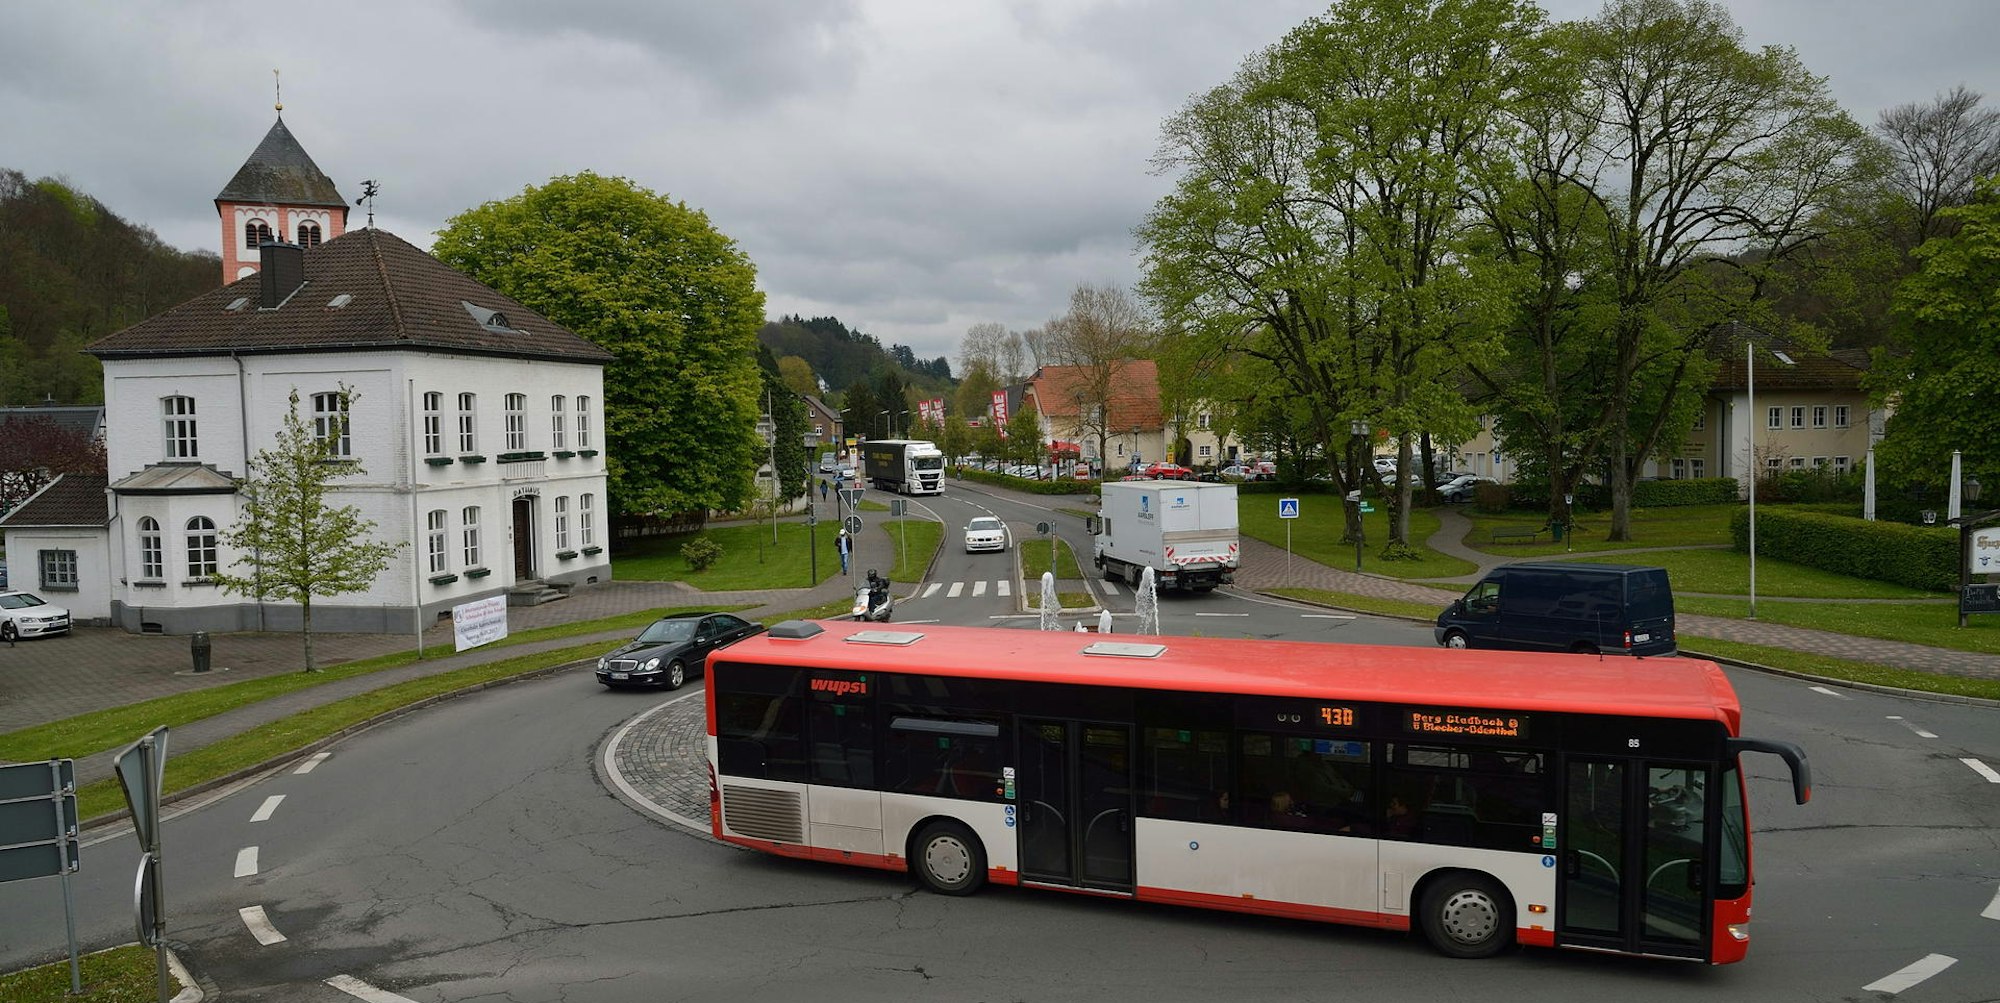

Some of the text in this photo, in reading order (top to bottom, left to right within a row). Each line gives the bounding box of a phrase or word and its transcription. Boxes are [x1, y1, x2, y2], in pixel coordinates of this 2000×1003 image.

[513, 486, 541, 497] RATHAUS
[811, 676, 867, 696] wupsi
[1321, 707, 1353, 726] 430
[1412, 713, 1442, 724] Berg
[1446, 714, 1504, 727] Gladbach
[1628, 738, 1640, 748] 85
